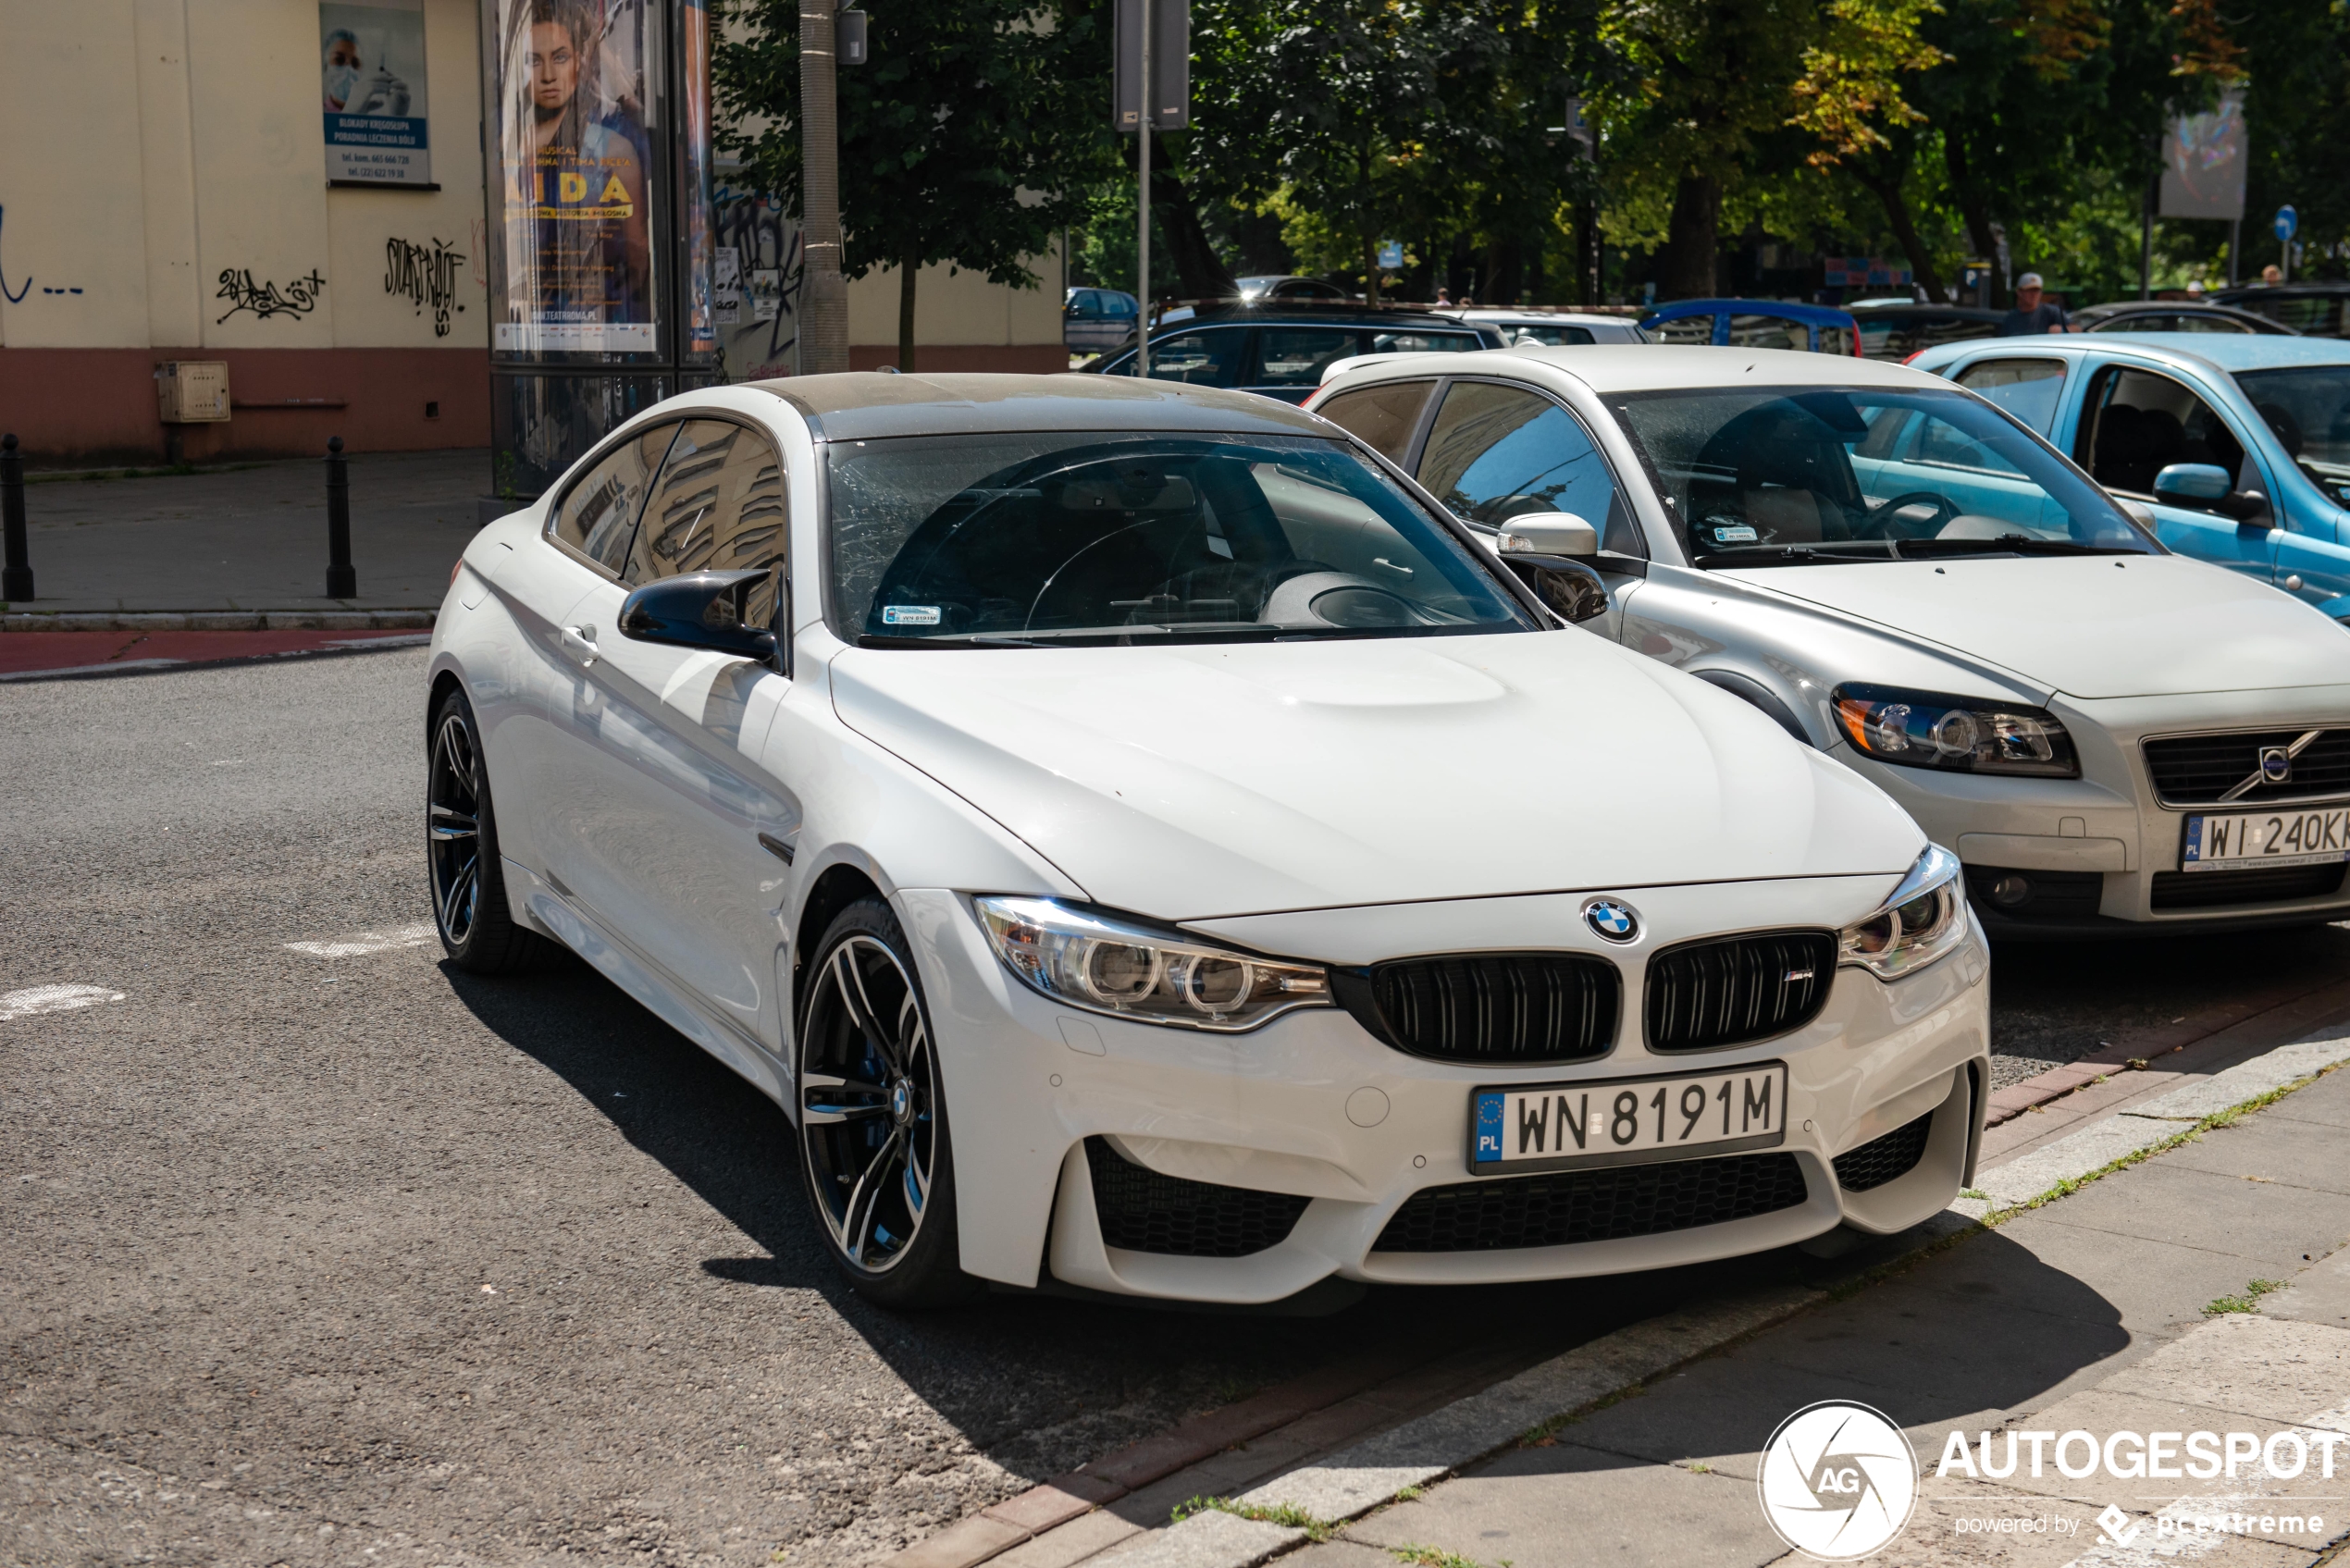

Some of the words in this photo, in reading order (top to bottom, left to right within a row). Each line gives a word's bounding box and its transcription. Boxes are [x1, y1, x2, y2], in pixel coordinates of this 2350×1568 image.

[340, 118, 369, 128] BLOKADY
[537, 146, 577, 154] MUSICAL
[570, 157, 595, 167] TIMA
[504, 172, 632, 203] AIDA
[2210, 819, 2246, 858] WI
[2186, 844, 2198, 856] PL
[1589, 901, 1627, 916] BMW
[1518, 1094, 1589, 1154] WN
[1611, 1075, 1772, 1145] 8191M
[1479, 1135, 1499, 1151] PL
